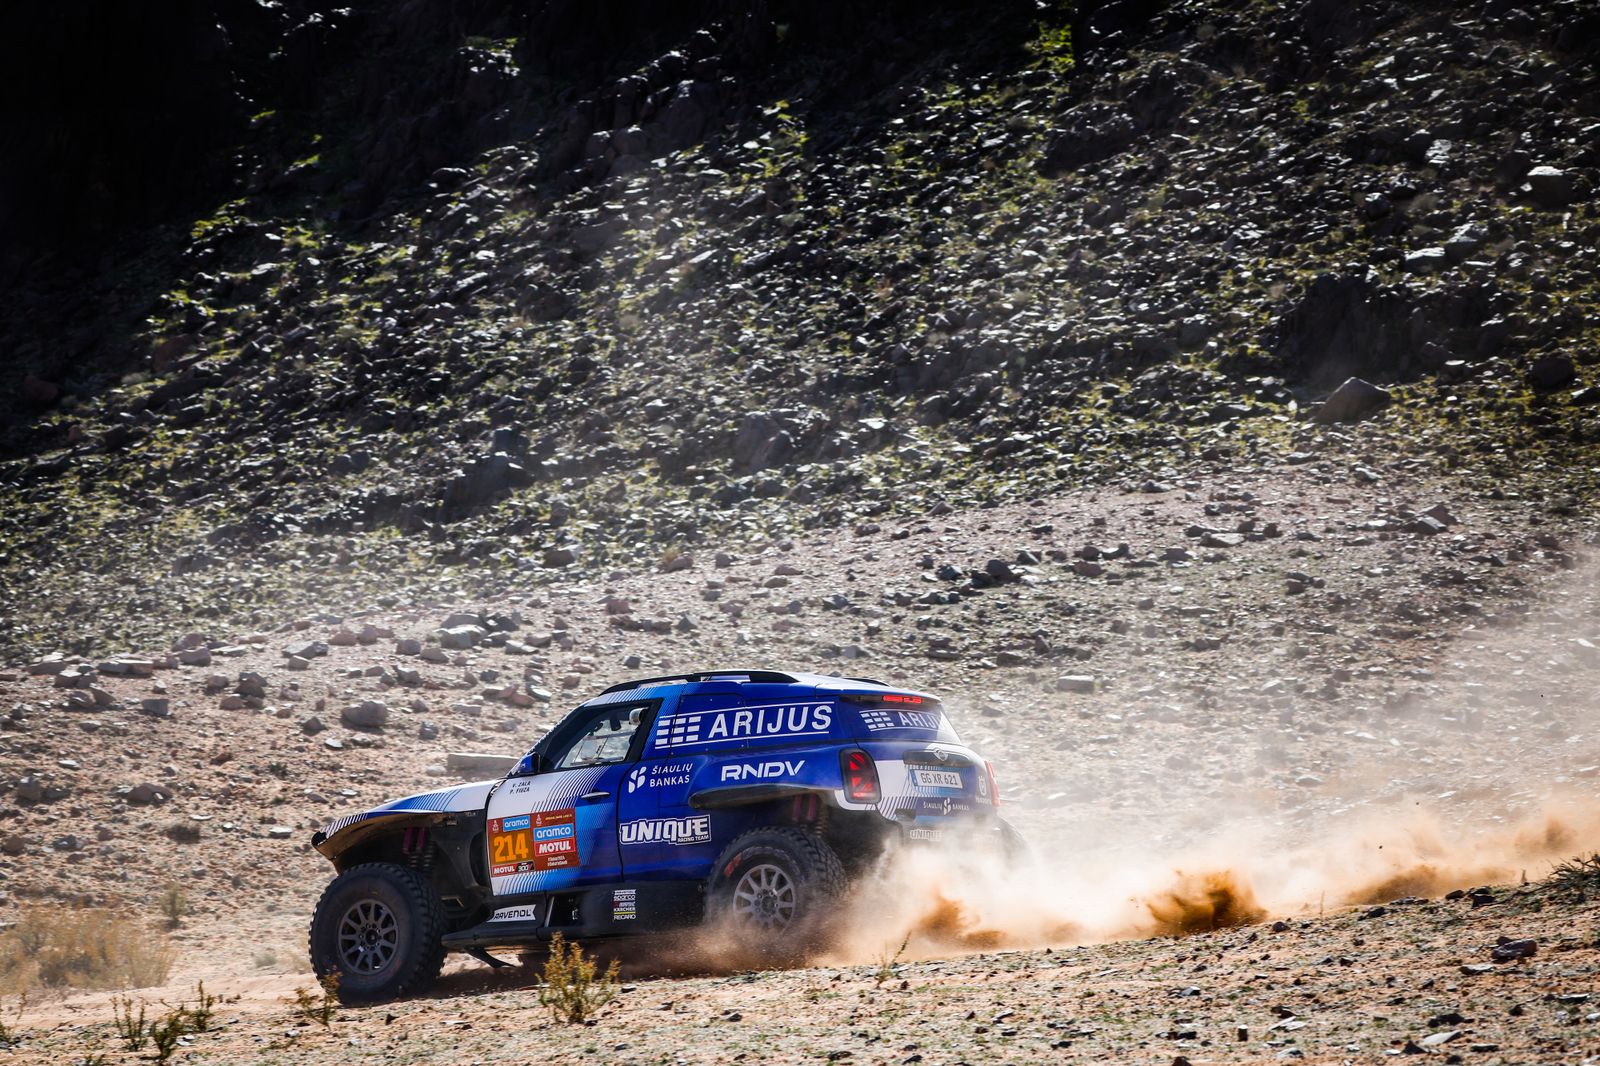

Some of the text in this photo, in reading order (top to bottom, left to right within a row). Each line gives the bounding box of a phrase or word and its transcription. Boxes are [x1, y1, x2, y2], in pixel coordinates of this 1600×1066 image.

[708, 705, 833, 739] ARIJUS
[651, 762, 693, 775] ŠIAULIŲ
[721, 760, 806, 782] RNDV
[650, 774, 690, 788] BANKAS
[920, 772, 958, 786] GG XR 621
[504, 819, 528, 828] aramco
[622, 818, 708, 842] UNIQUE
[536, 826, 572, 839] aramco
[494, 833, 528, 863] 214
[539, 840, 571, 854] MOTUL
[493, 865, 515, 874] MOTUL
[494, 908, 532, 920] RAVENOL
